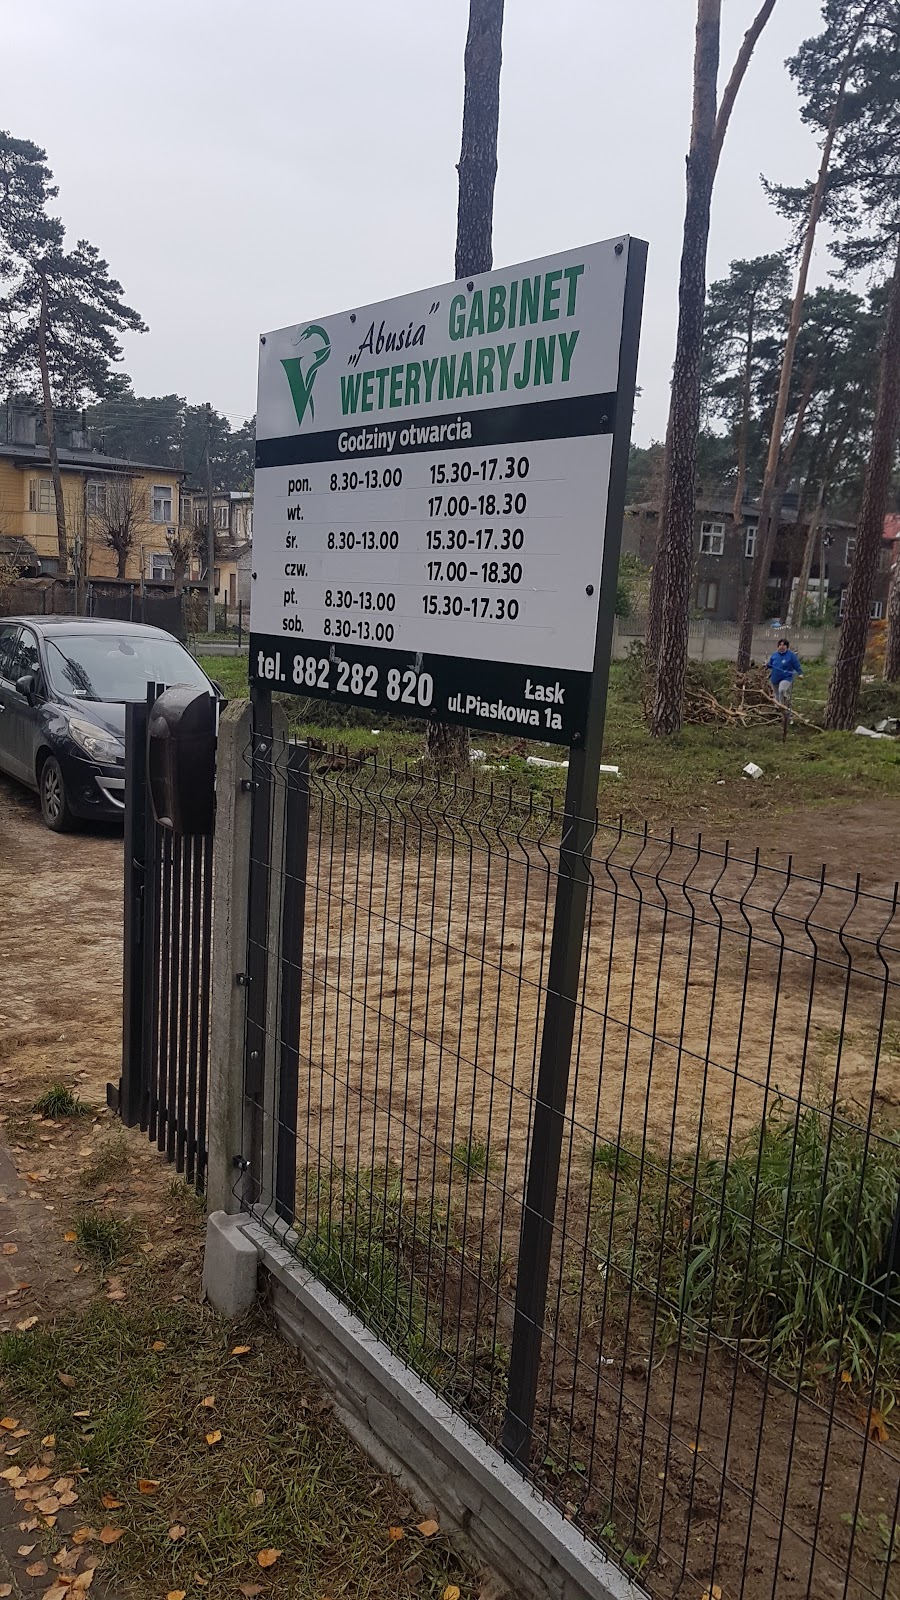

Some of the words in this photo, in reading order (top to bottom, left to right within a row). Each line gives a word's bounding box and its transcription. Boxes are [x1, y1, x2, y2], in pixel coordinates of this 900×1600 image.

[449, 264, 585, 341] GABINET
[340, 330, 580, 415] WETERYNARYJNY
[338, 427, 396, 452] Godziny
[400, 416, 472, 446] otwarcia
[288, 478, 312, 496] pon.
[330, 468, 402, 491] 8.30-13.00
[430, 456, 529, 484] 15.30-17.30
[287, 504, 304, 520] wt.
[428, 493, 526, 517] 17.00-18.30
[286, 531, 298, 549] śr.
[327, 531, 399, 550] 8.30-13.00
[426, 528, 524, 550] 15.30-17.30
[284, 563, 308, 577] czw.
[283, 588, 298, 607] pt.
[324, 590, 395, 611] 8.30-13.00
[422, 595, 519, 620] 15.30-17.30
[282, 615, 304, 632] sob.
[323, 618, 394, 642] 8.30-13.00
[257, 651, 286, 682] tel.
[292, 654, 330, 689] 882
[336, 661, 379, 698] 282
[386, 668, 434, 707] 820
[524, 678, 565, 704] Łask
[447, 692, 540, 726] ul.Piaskowa
[544, 707, 562, 730] 1a
